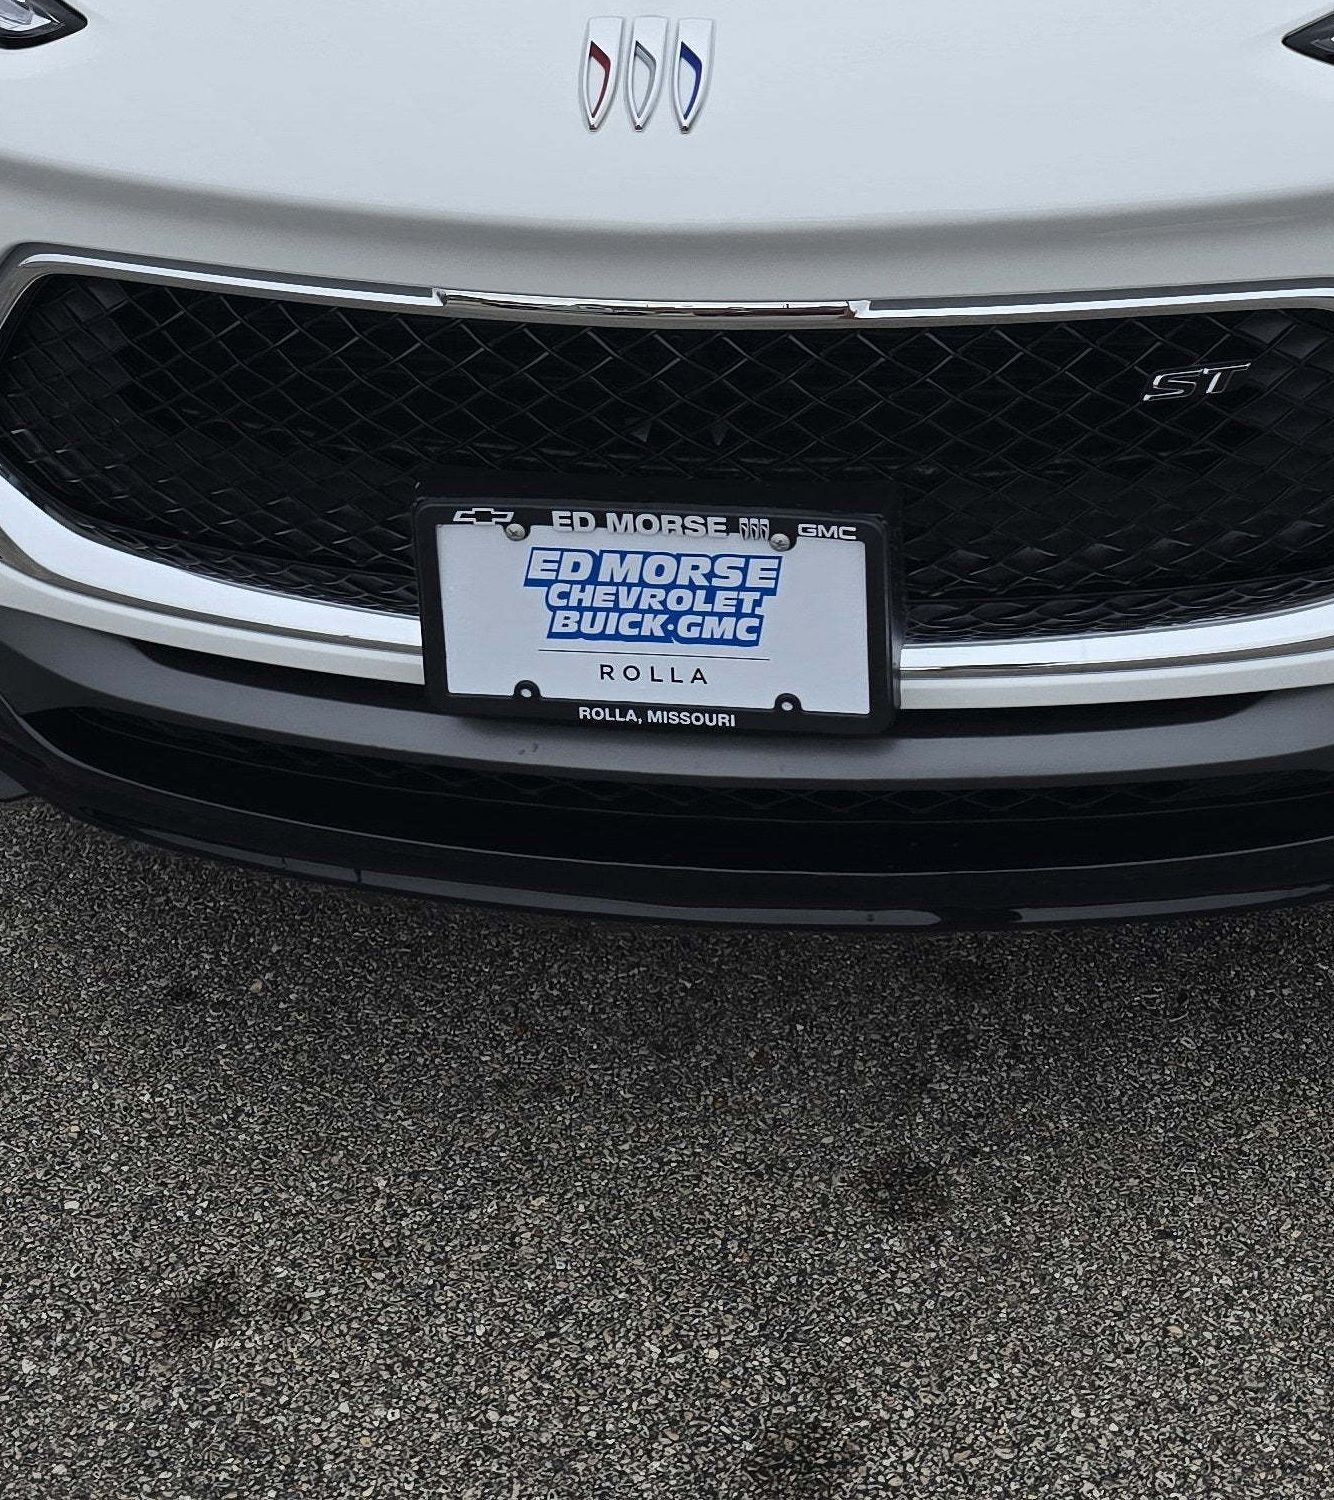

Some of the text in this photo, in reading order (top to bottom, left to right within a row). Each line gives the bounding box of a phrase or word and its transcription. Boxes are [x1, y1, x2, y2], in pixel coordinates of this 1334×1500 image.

[1143, 362, 1252, 401] ST
[551, 510, 729, 539] ED MORSE
[797, 523, 857, 541] GMC
[527, 549, 779, 589] ED MORSE
[546, 582, 761, 615] CHEVROLET
[599, 664, 709, 686] ROLLA
[578, 706, 737, 728] ROLLA, MISSOURI
